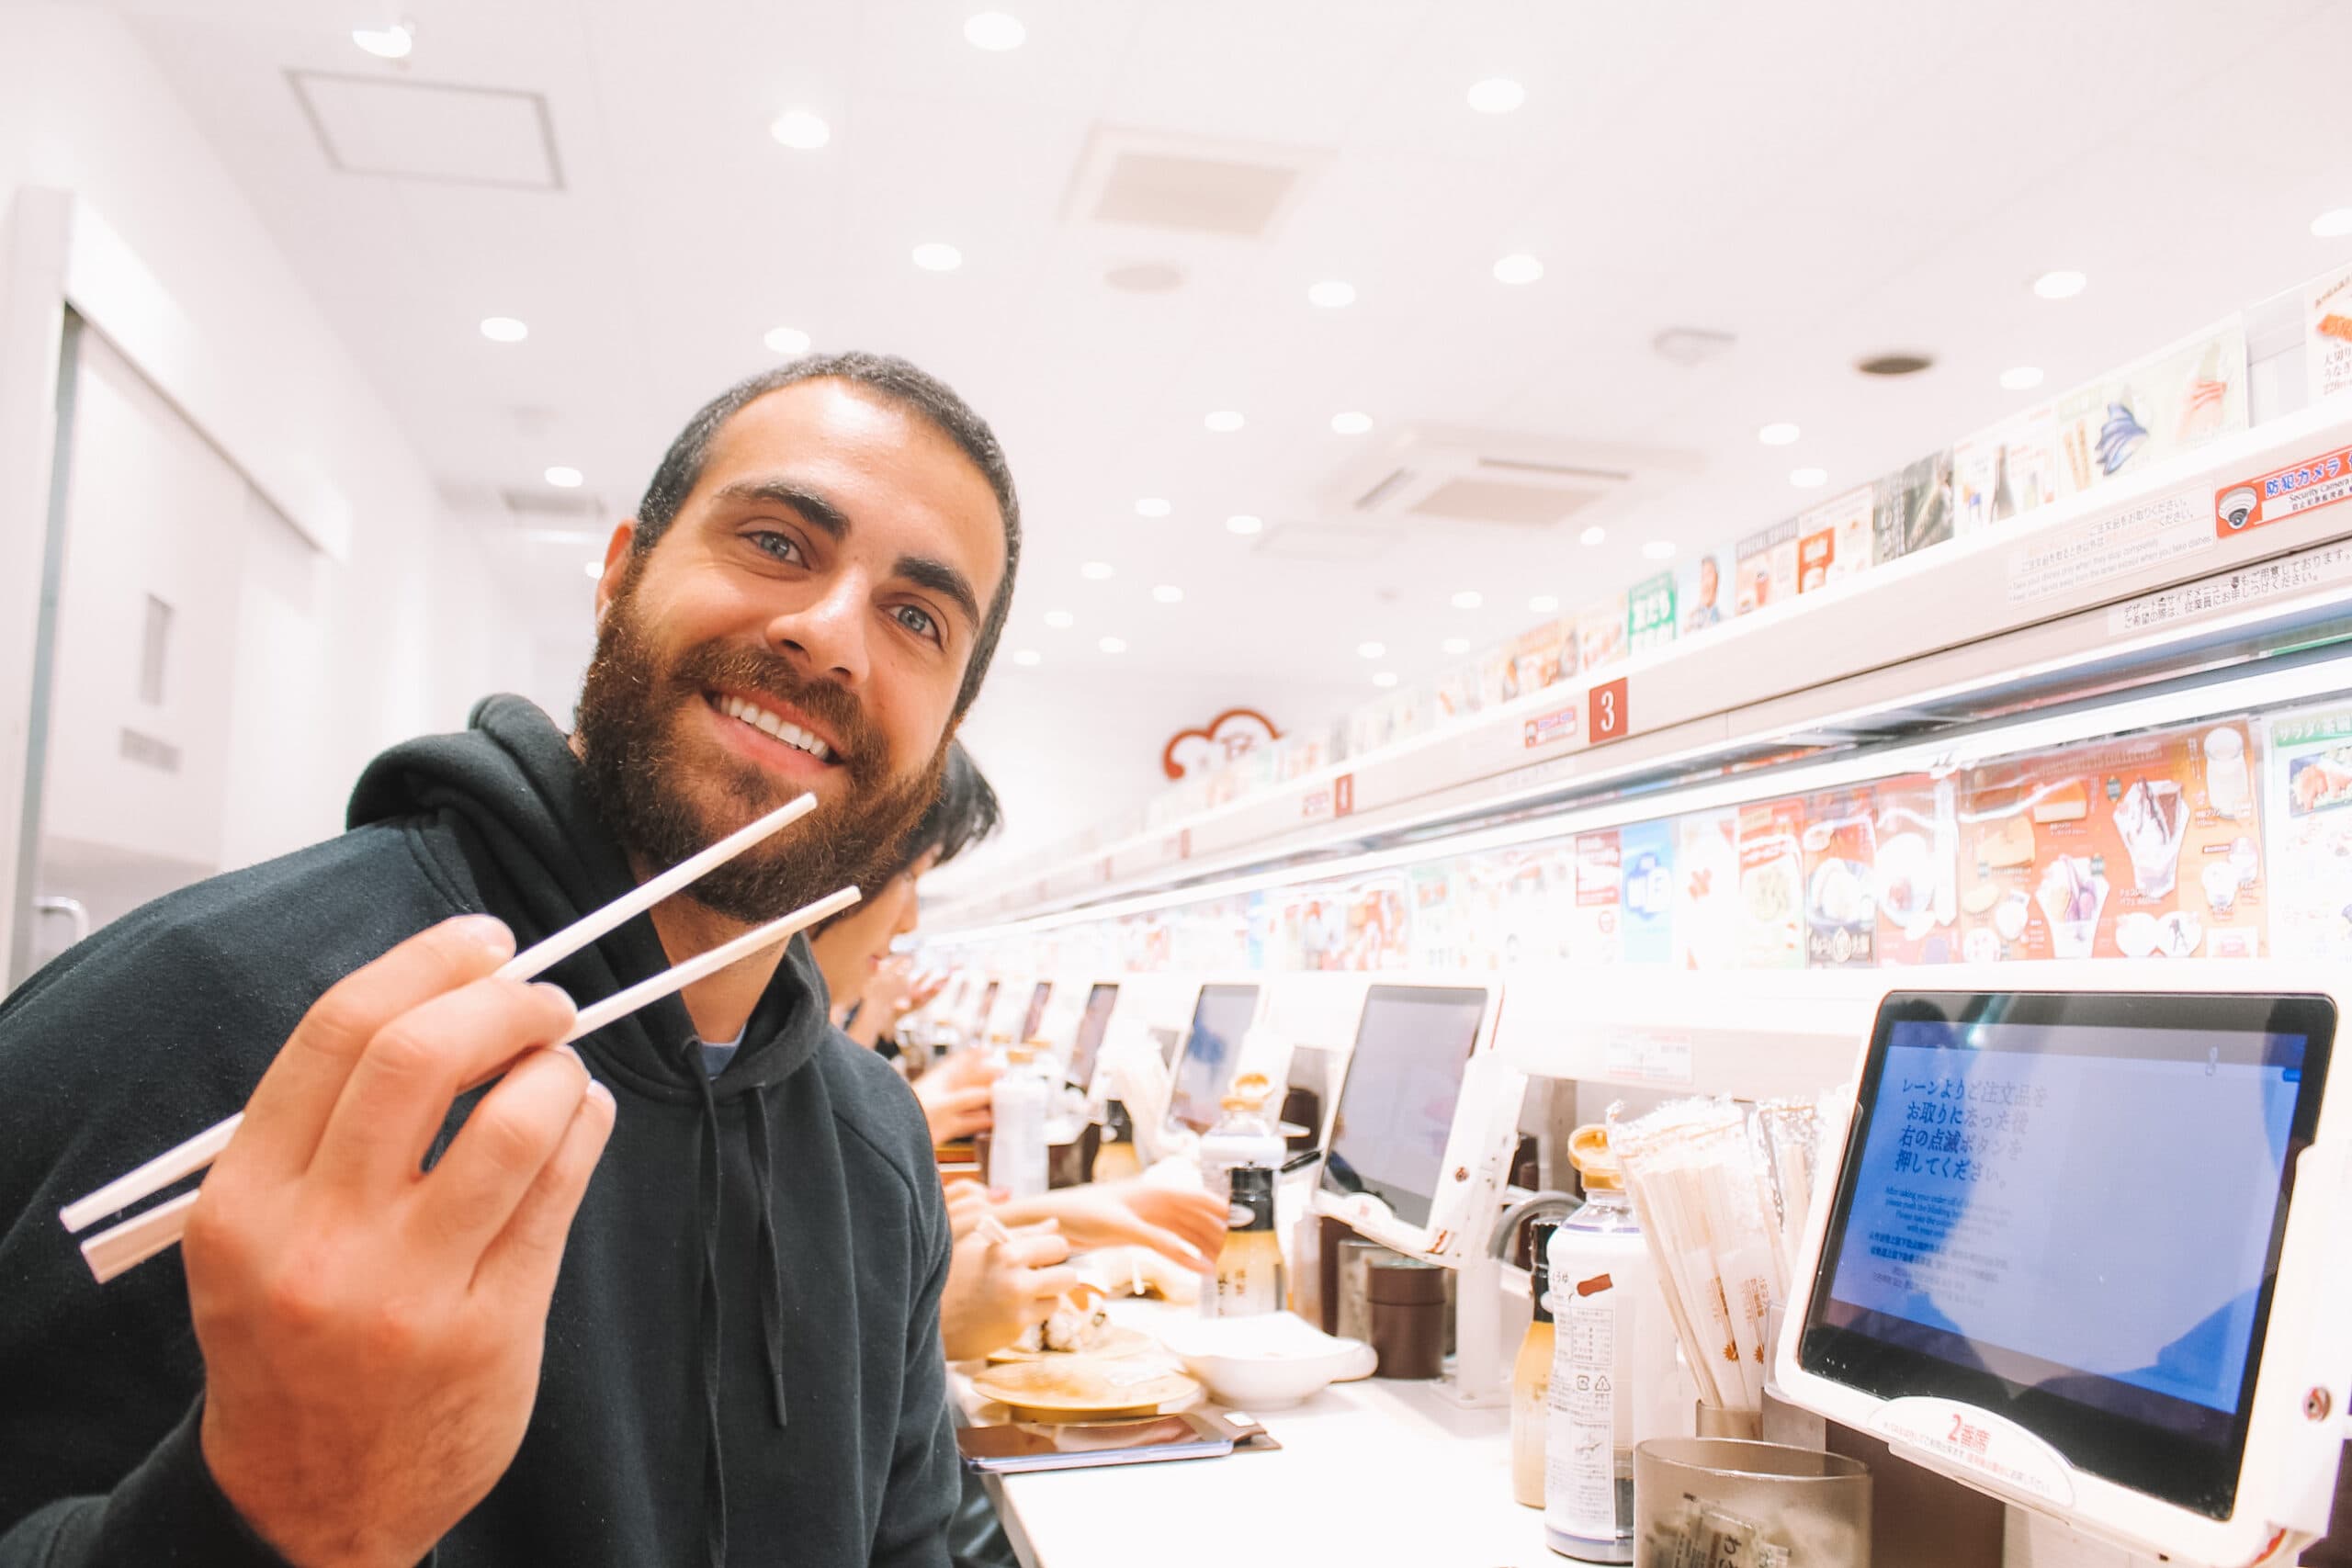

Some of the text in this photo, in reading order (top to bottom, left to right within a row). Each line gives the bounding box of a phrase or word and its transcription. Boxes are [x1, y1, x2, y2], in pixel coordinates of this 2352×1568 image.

[2265, 457, 2341, 498] 防犯カメラ
[2289, 478, 2350, 502] Security Camera
[1600, 689, 1615, 732] 3
[1902, 1077, 2049, 1109] レーンよりご注文品を
[1905, 1100, 2030, 1134] お取りになった後
[1898, 1123, 2023, 1161] 右の点滅ボタンを
[1894, 1148, 2007, 1191] 押してください。
[1946, 1412, 1992, 1455] 2番席
